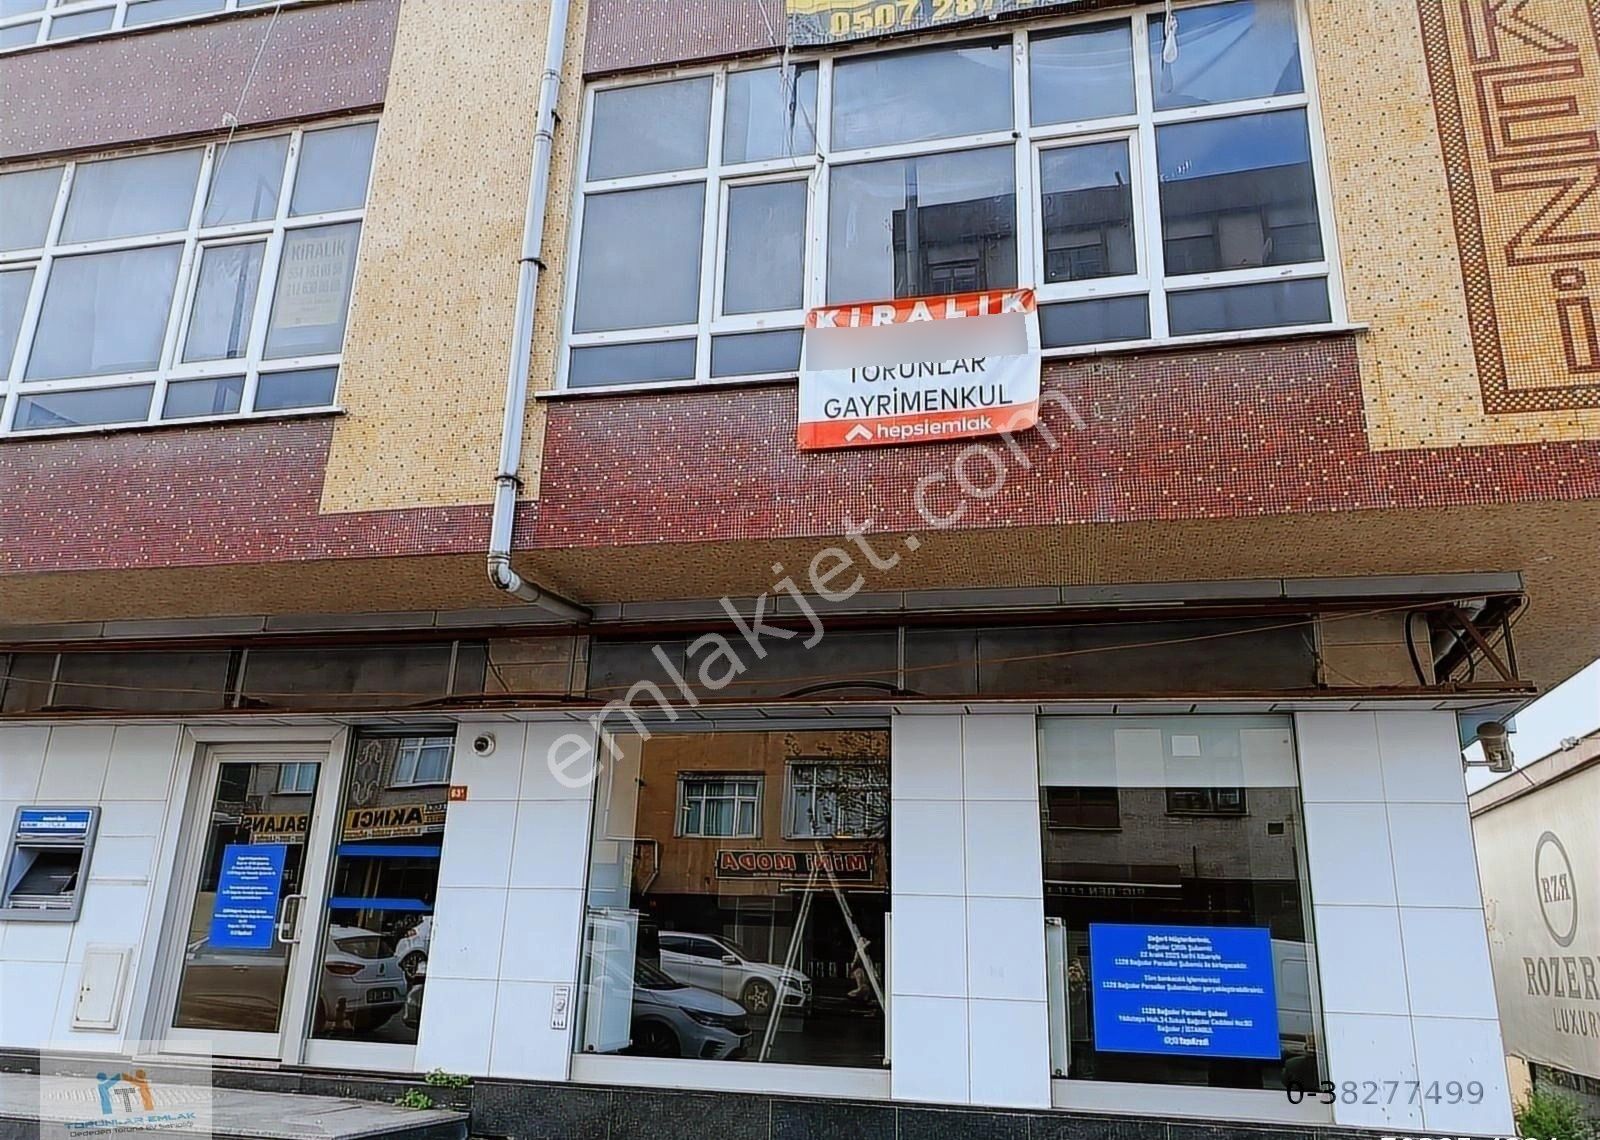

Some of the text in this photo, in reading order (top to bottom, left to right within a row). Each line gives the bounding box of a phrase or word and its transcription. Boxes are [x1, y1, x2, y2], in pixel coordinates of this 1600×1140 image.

[815, 293, 1028, 328] KİRALIK
[823, 384, 1013, 418] GAYRİMENKUL
[1523, 956, 1600, 1000] ROZER
[1553, 1007, 1600, 1038] LUXUR
